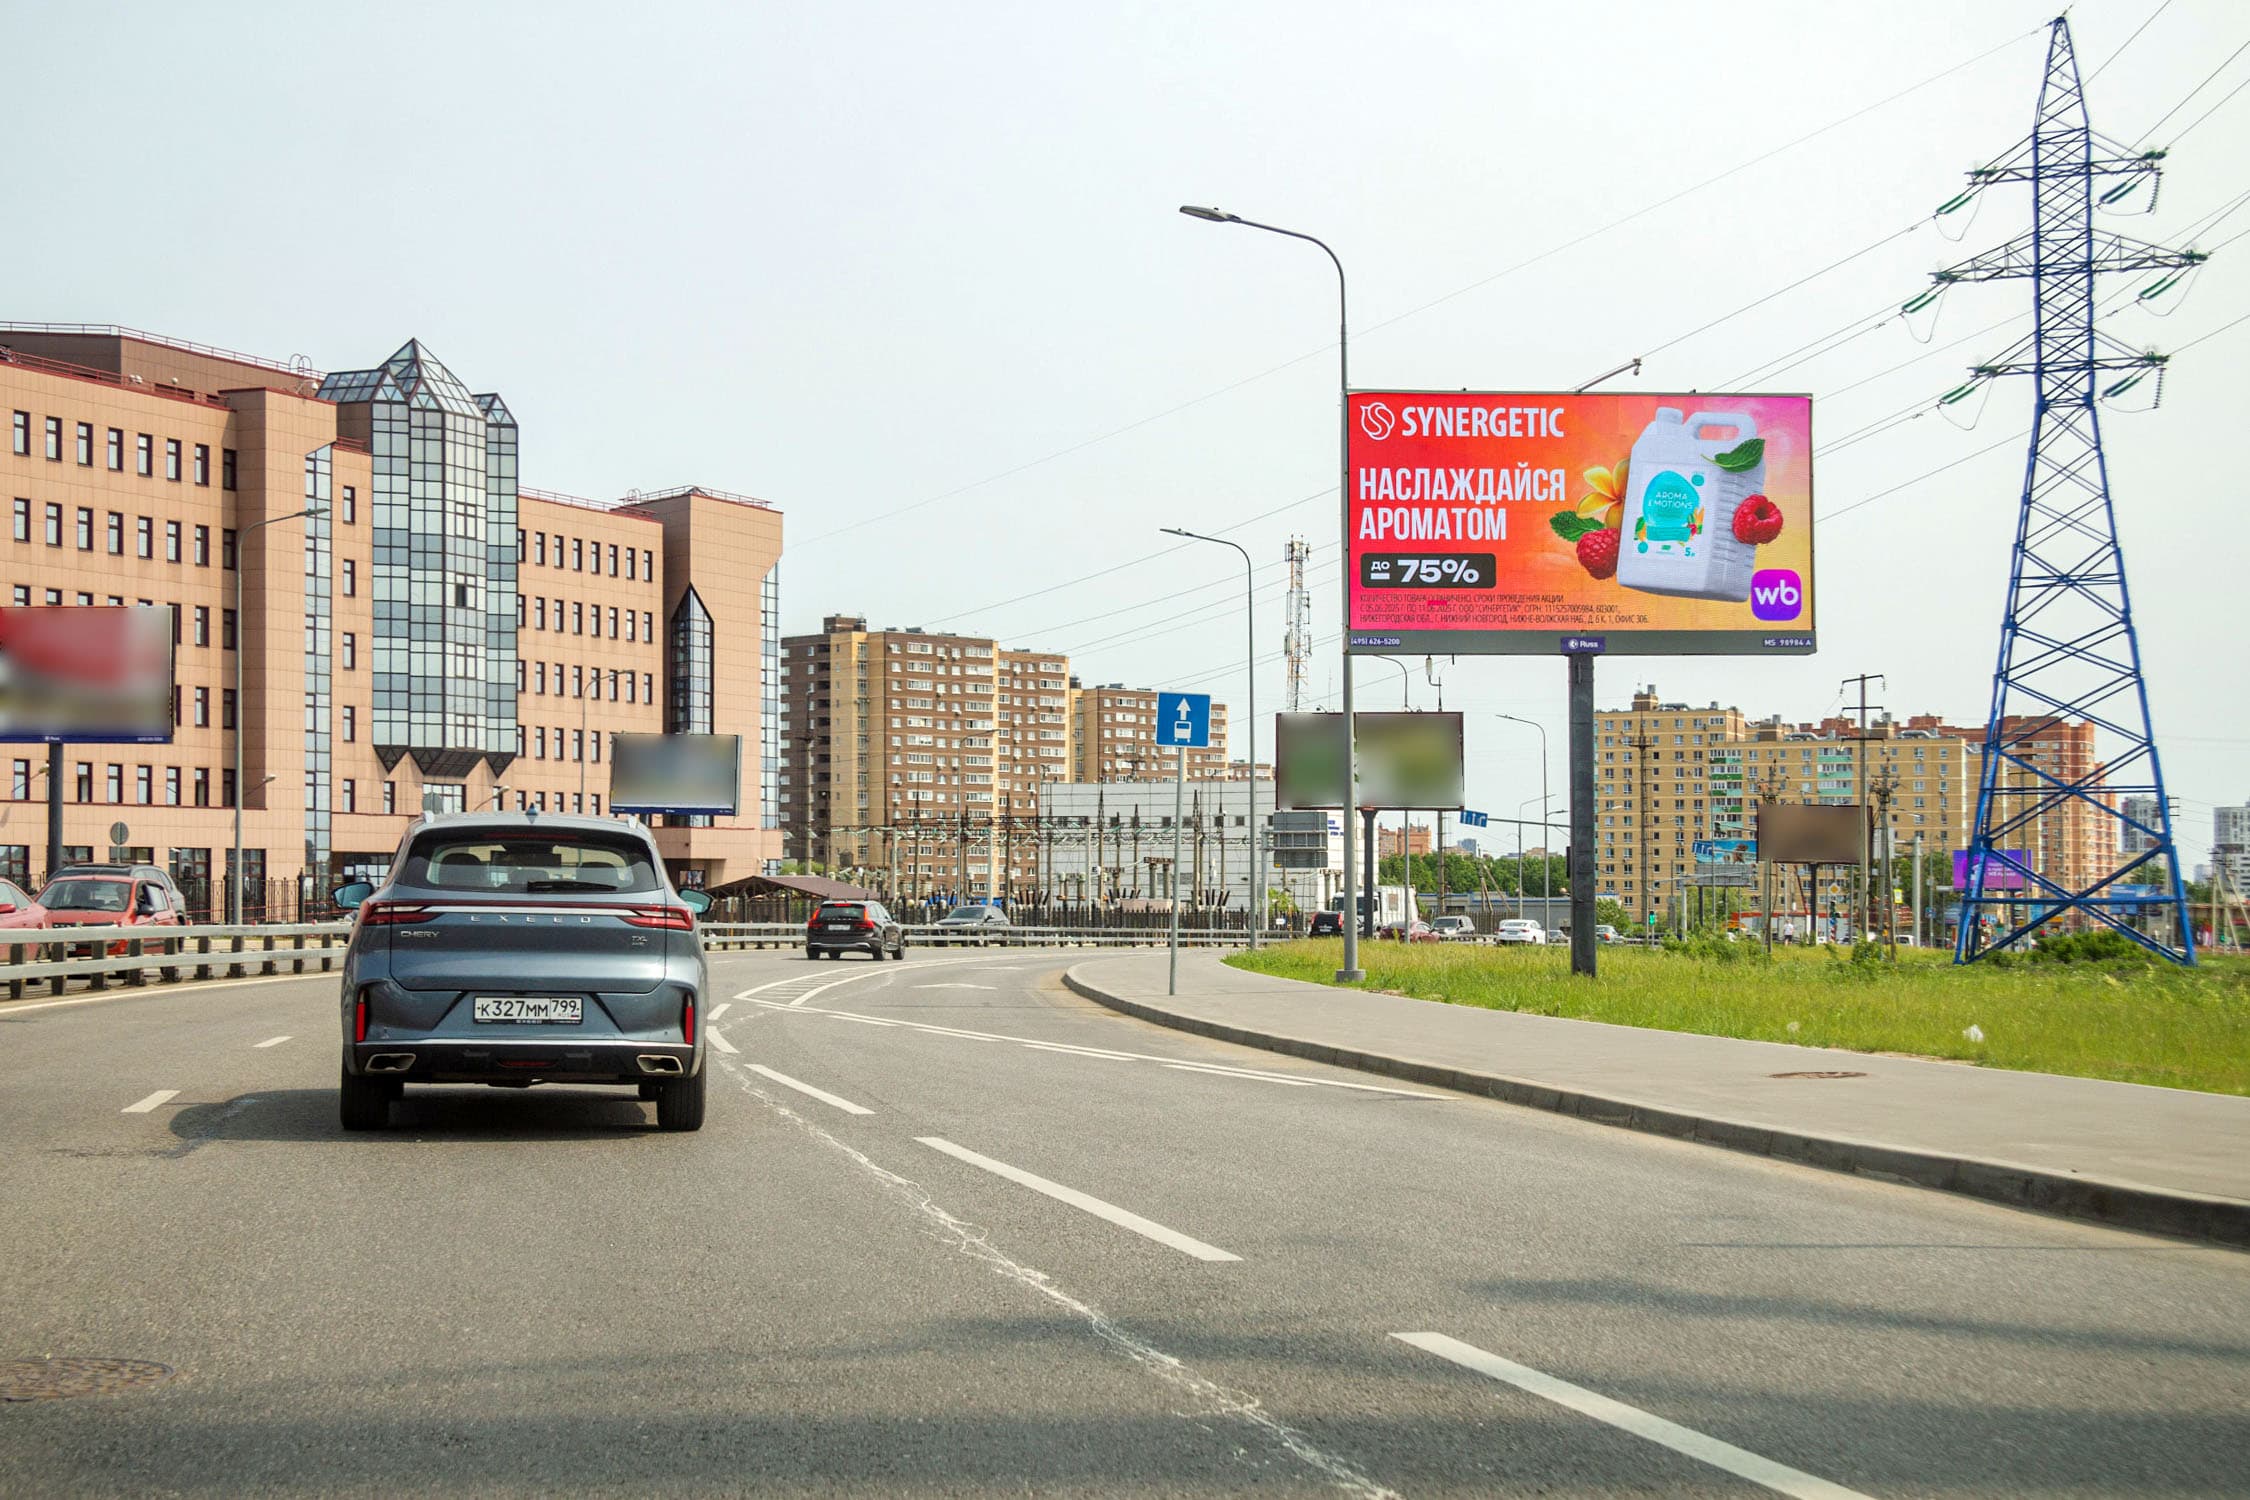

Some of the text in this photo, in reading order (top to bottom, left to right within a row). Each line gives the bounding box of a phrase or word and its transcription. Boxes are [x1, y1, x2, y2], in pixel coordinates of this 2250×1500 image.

[1402, 406, 1564, 437] SYNERGETIC
[1360, 462, 1565, 504] НАСЛАЖДАЙСЯ
[1655, 491, 1688, 500] AROMA
[1648, 500, 1693, 510] EMOTIONS
[1360, 507, 1507, 541] АРОМАТОМ
[1754, 579, 1799, 606] wb
[1458, 604, 1474, 613] ООО
[1580, 639, 1599, 648] Russ
[471, 915, 591, 923] EXEED
[400, 930, 440, 938] CHERY
[551, 1000, 577, 1013] 799
